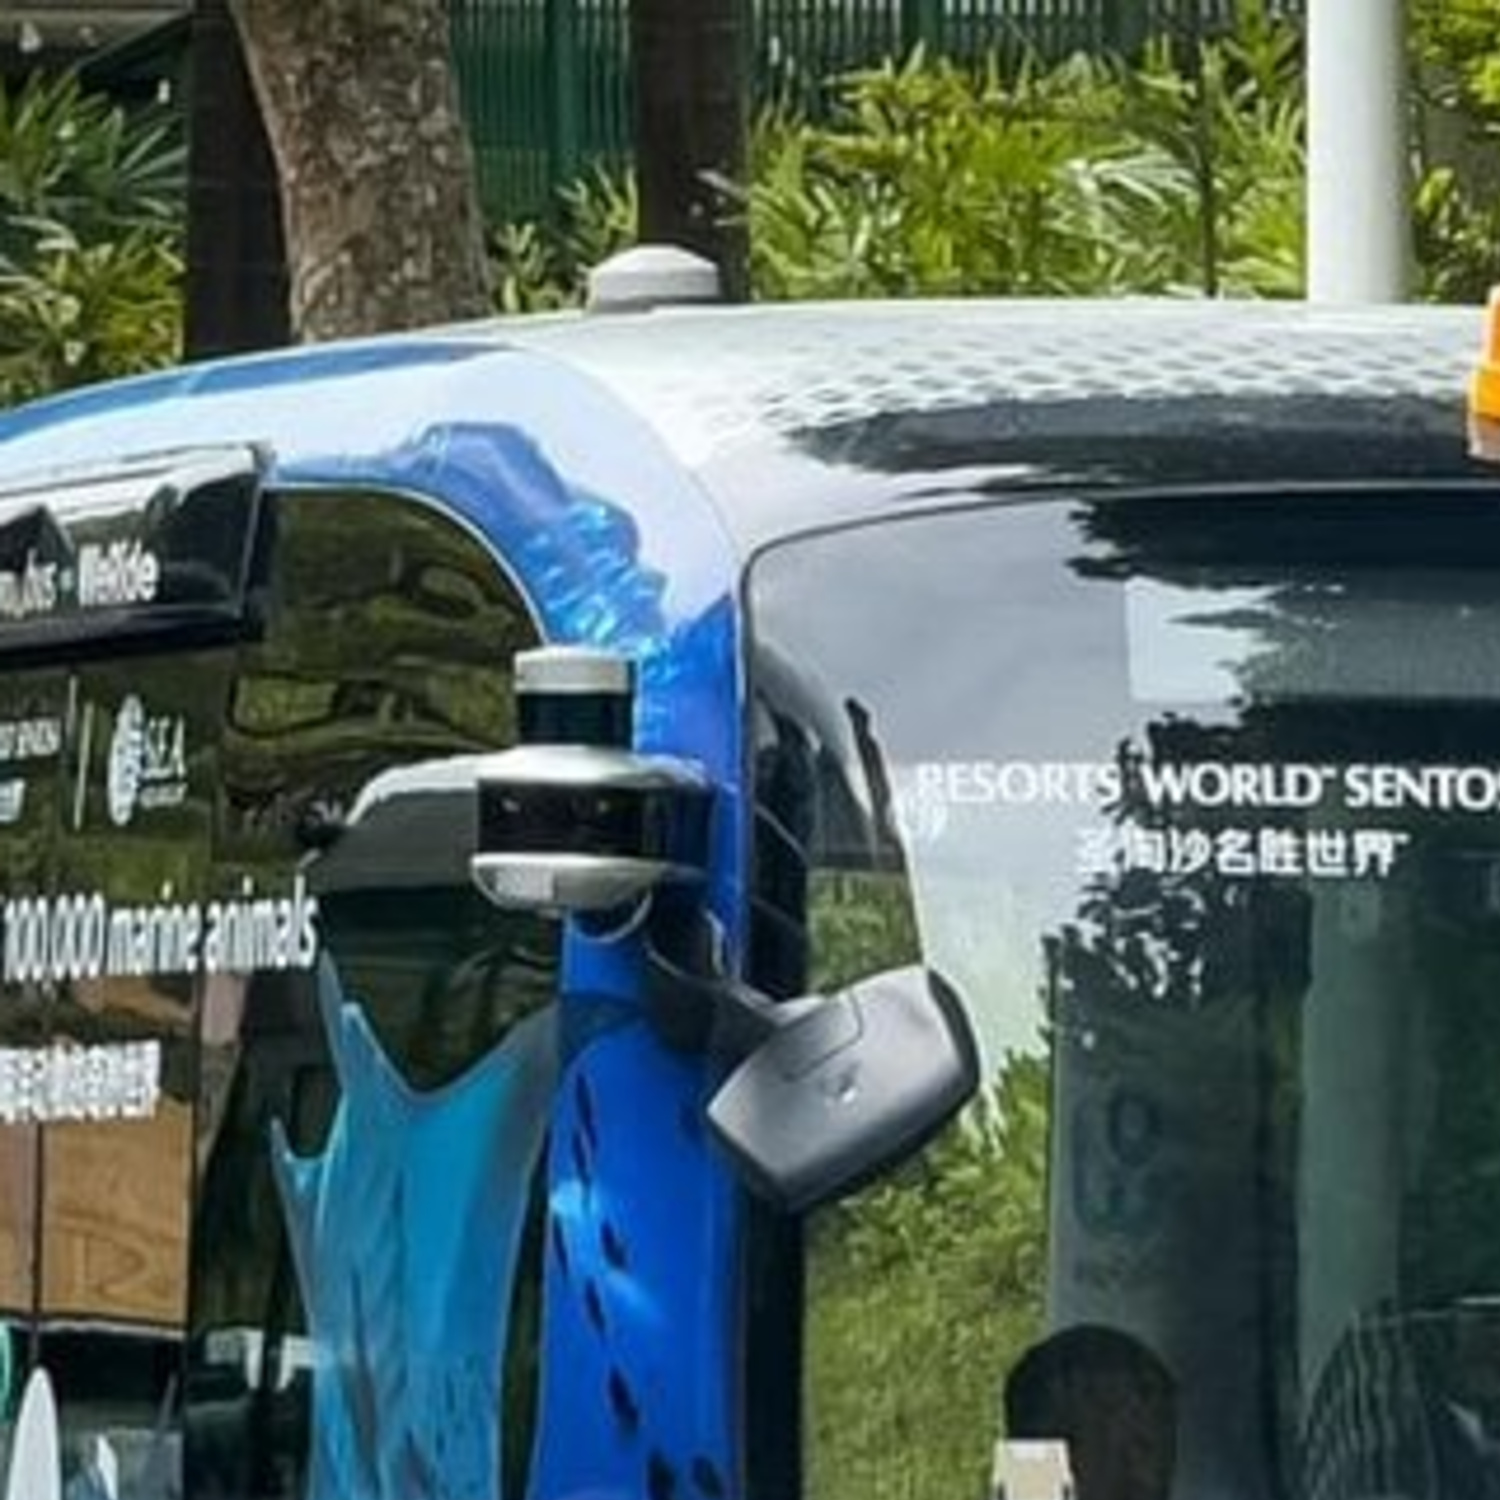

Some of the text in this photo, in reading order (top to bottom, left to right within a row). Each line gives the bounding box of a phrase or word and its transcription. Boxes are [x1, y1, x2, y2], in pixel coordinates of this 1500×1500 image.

[916, 762, 1122, 804] RESORTS
[107, 880, 201, 974] marine
[205, 874, 319, 971] animals
